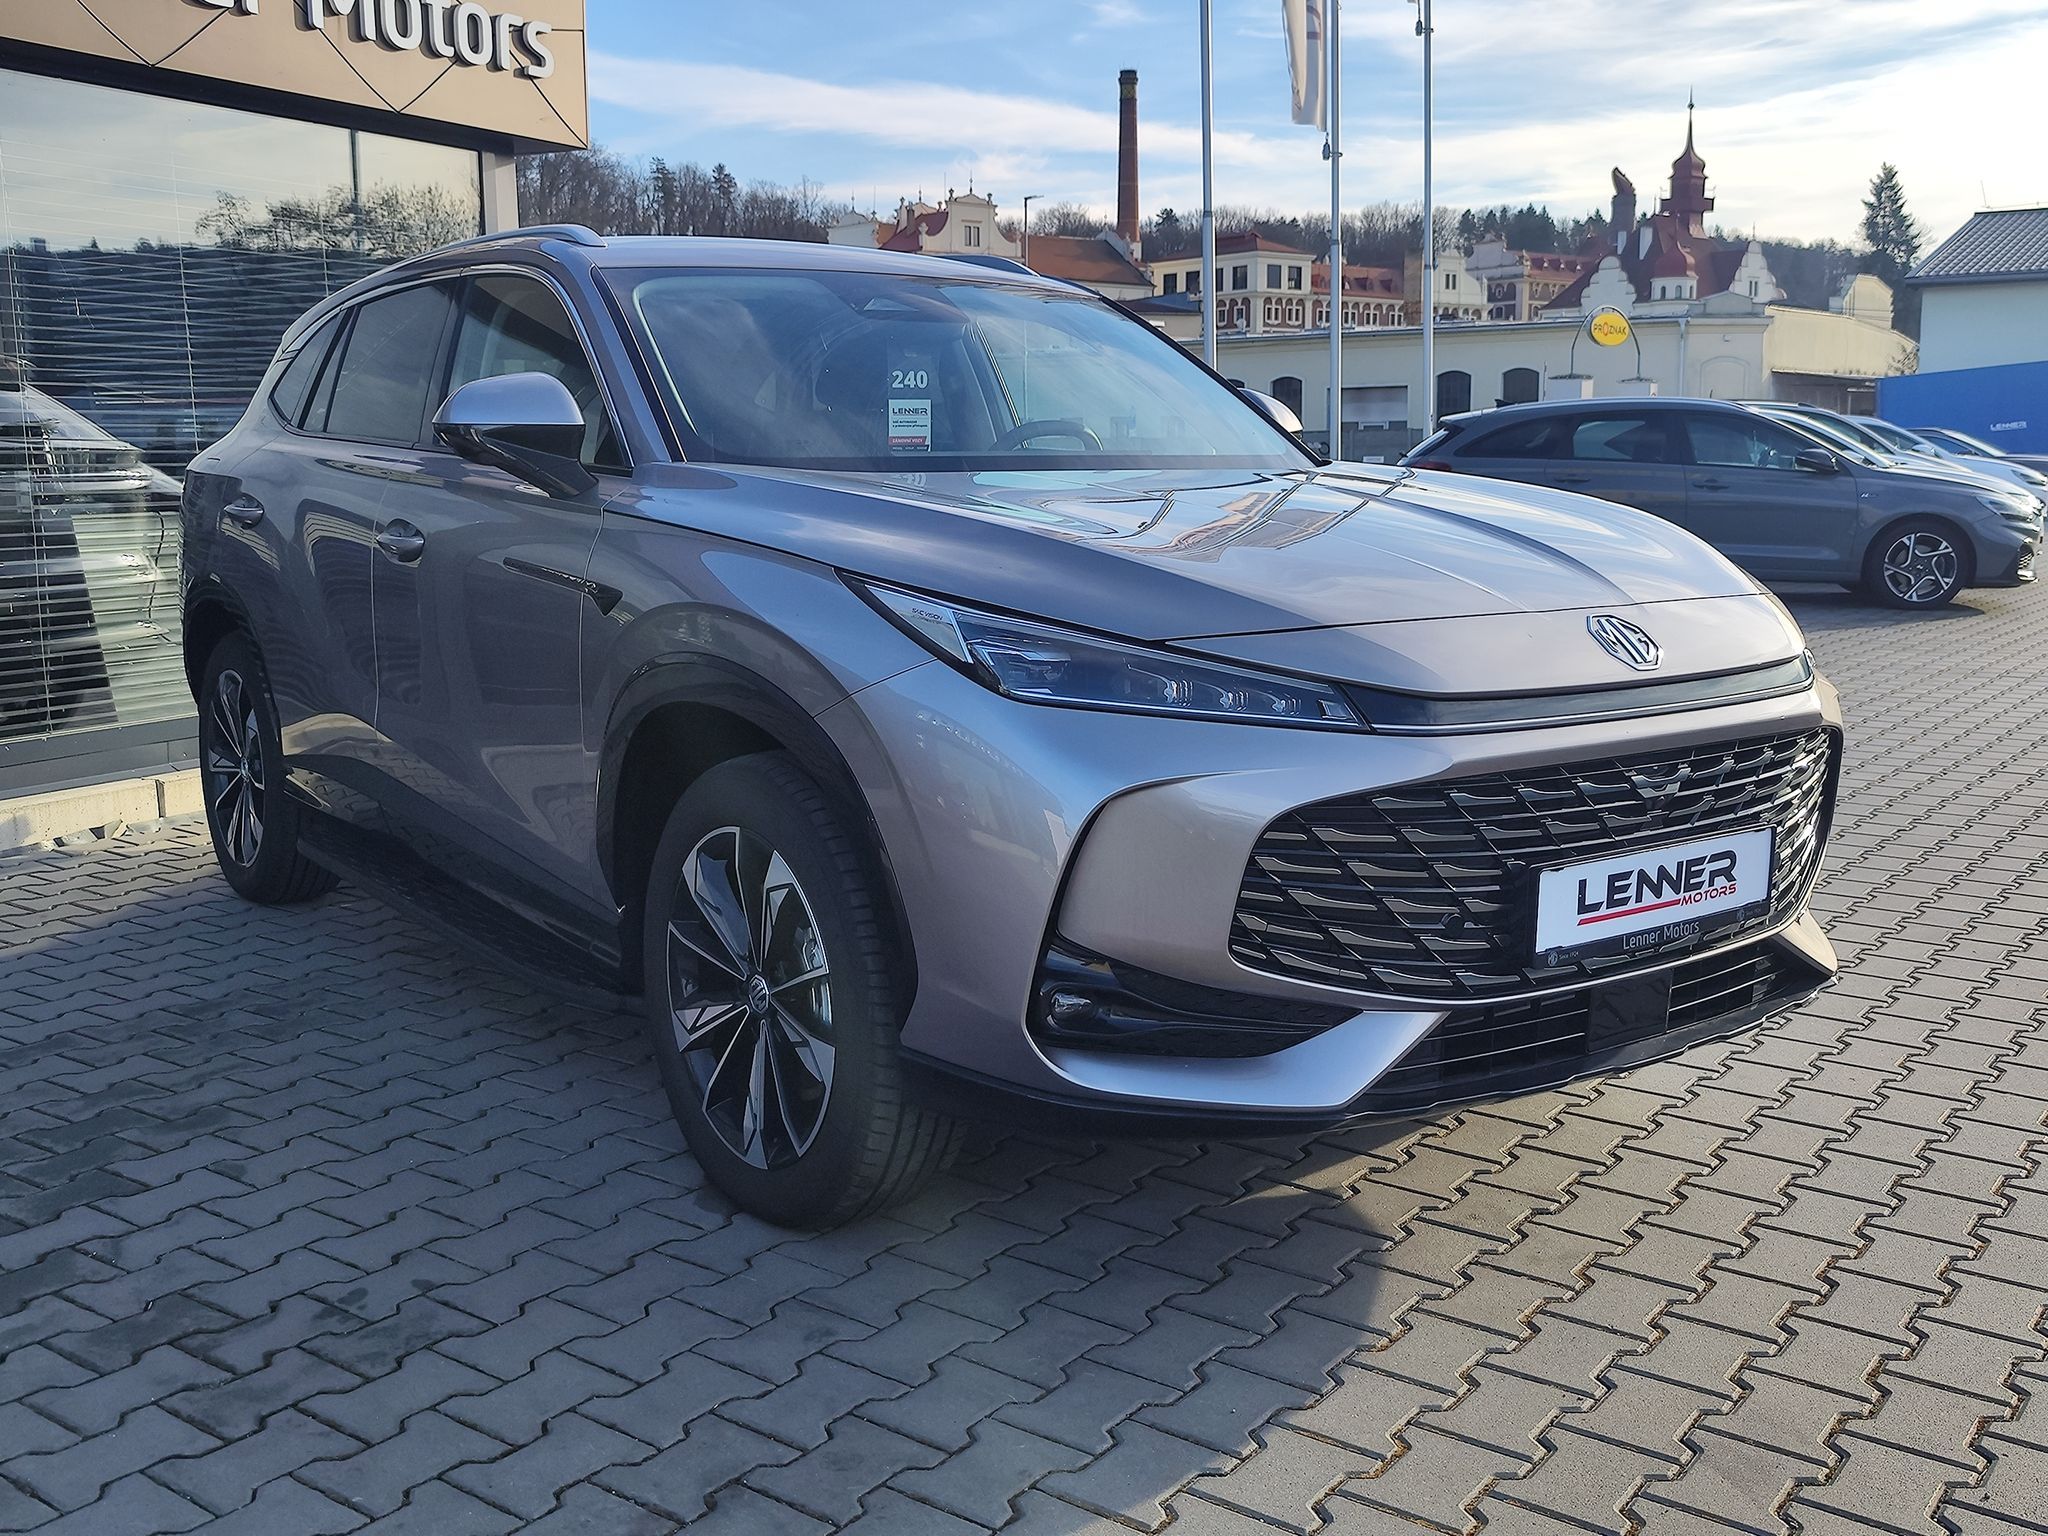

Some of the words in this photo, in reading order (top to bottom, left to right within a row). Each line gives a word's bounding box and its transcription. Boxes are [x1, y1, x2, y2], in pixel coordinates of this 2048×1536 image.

[891, 370, 928, 389] 240
[892, 407, 928, 416] LENNER
[1590, 616, 1660, 667] MG
[1577, 850, 1738, 916] LENNER
[1680, 882, 1737, 907] MOTORS
[1622, 928, 1661, 950] Lenner
[1664, 921, 1700, 940] Motors
